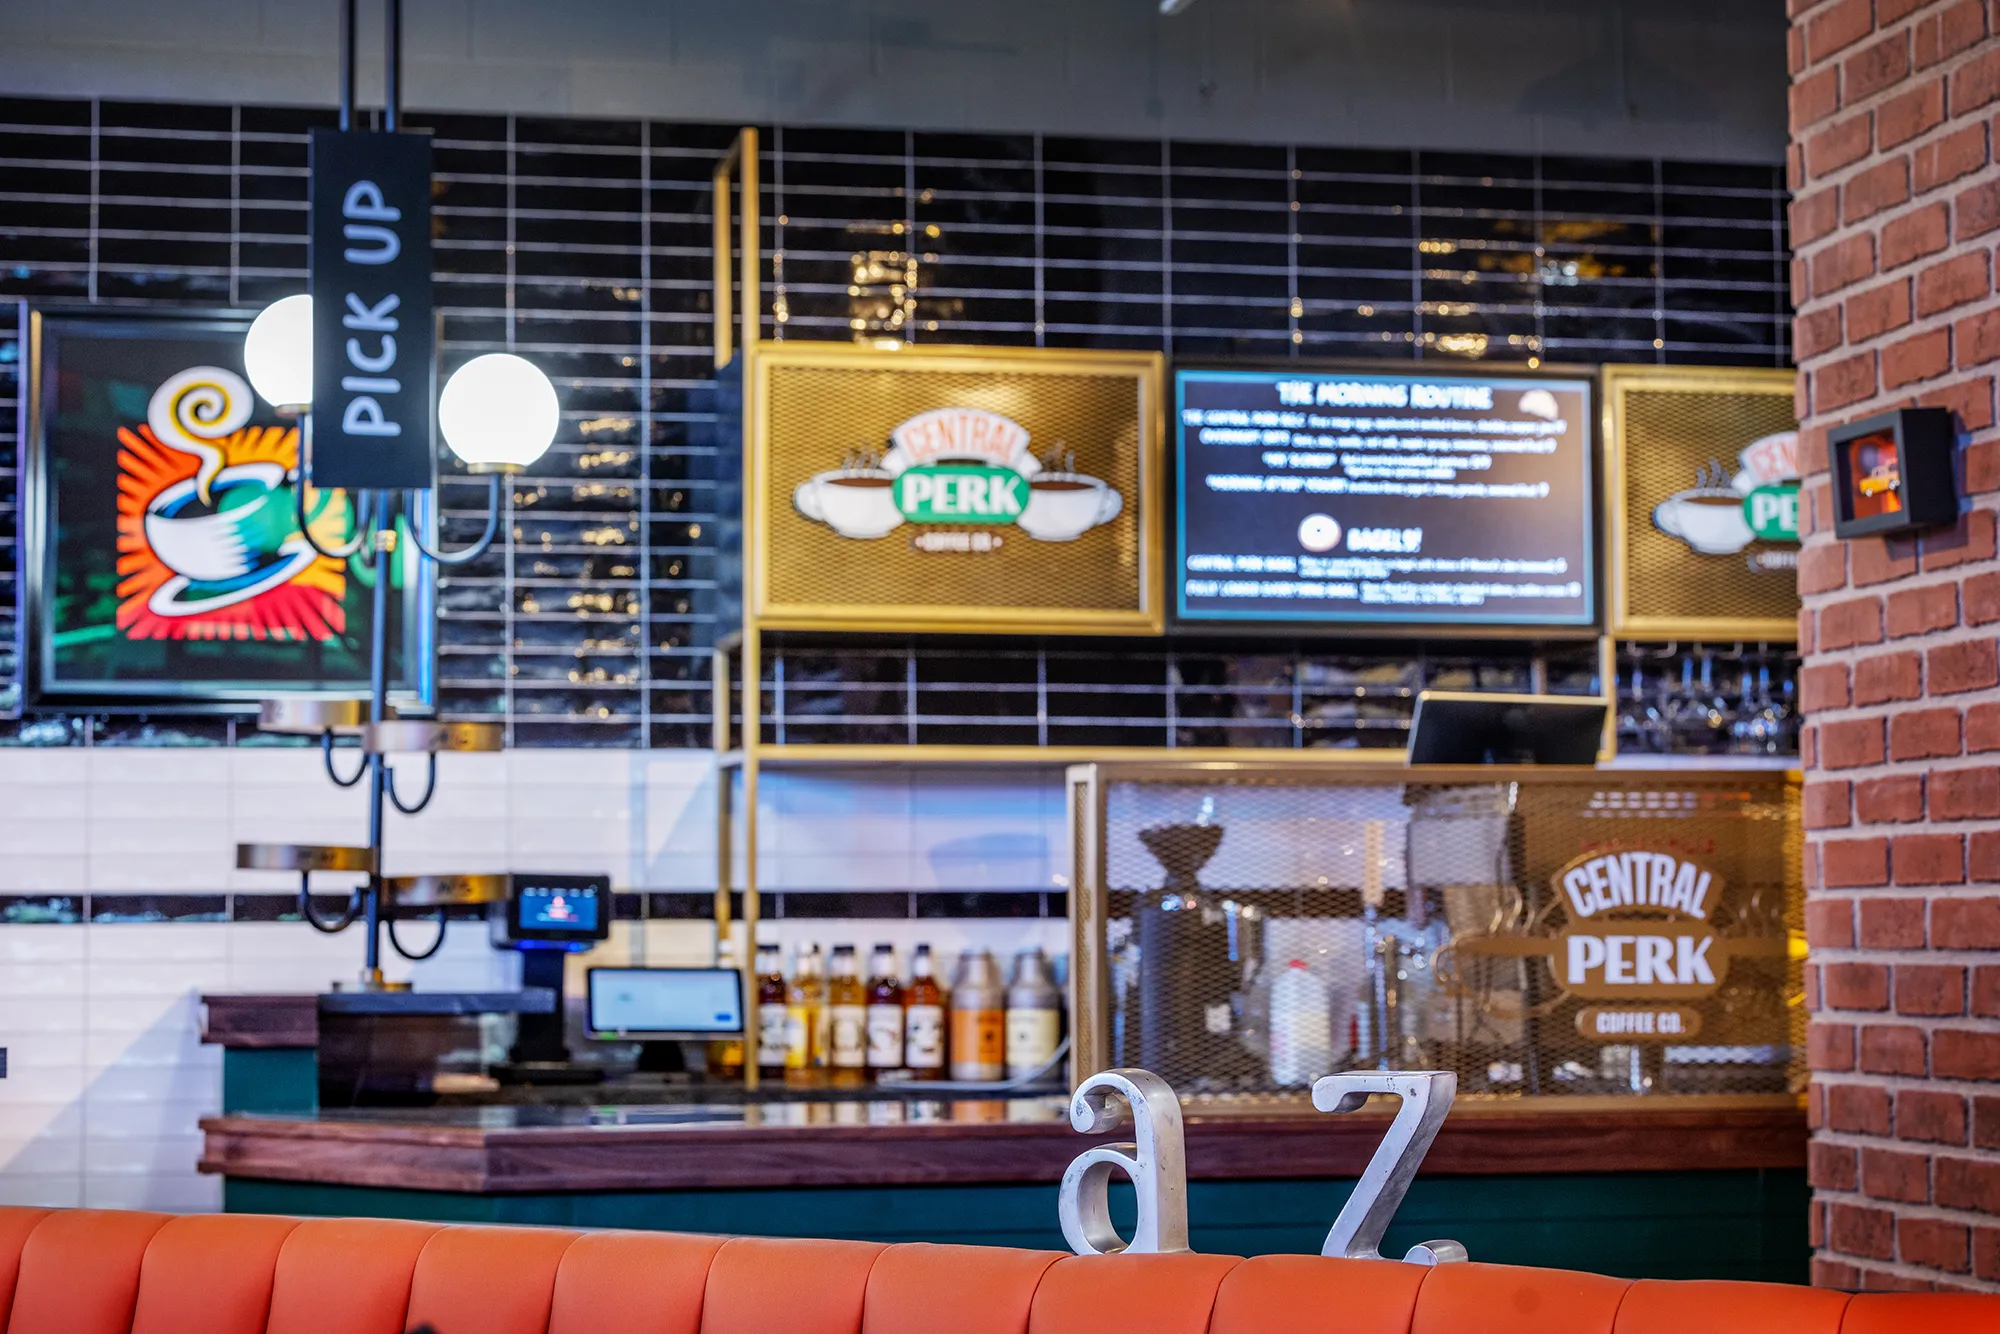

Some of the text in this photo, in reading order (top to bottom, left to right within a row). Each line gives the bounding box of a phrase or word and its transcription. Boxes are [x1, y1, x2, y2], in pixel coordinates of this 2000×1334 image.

[341, 179, 402, 437] PICK UP
[902, 412, 1021, 462] CENTRAL
[902, 473, 1023, 515] PERK
[1751, 492, 1799, 532] PE
[1563, 851, 1713, 919] CENTRAL
[1566, 935, 1716, 985] PERK
[1596, 1011, 1655, 1034] COFFEE
